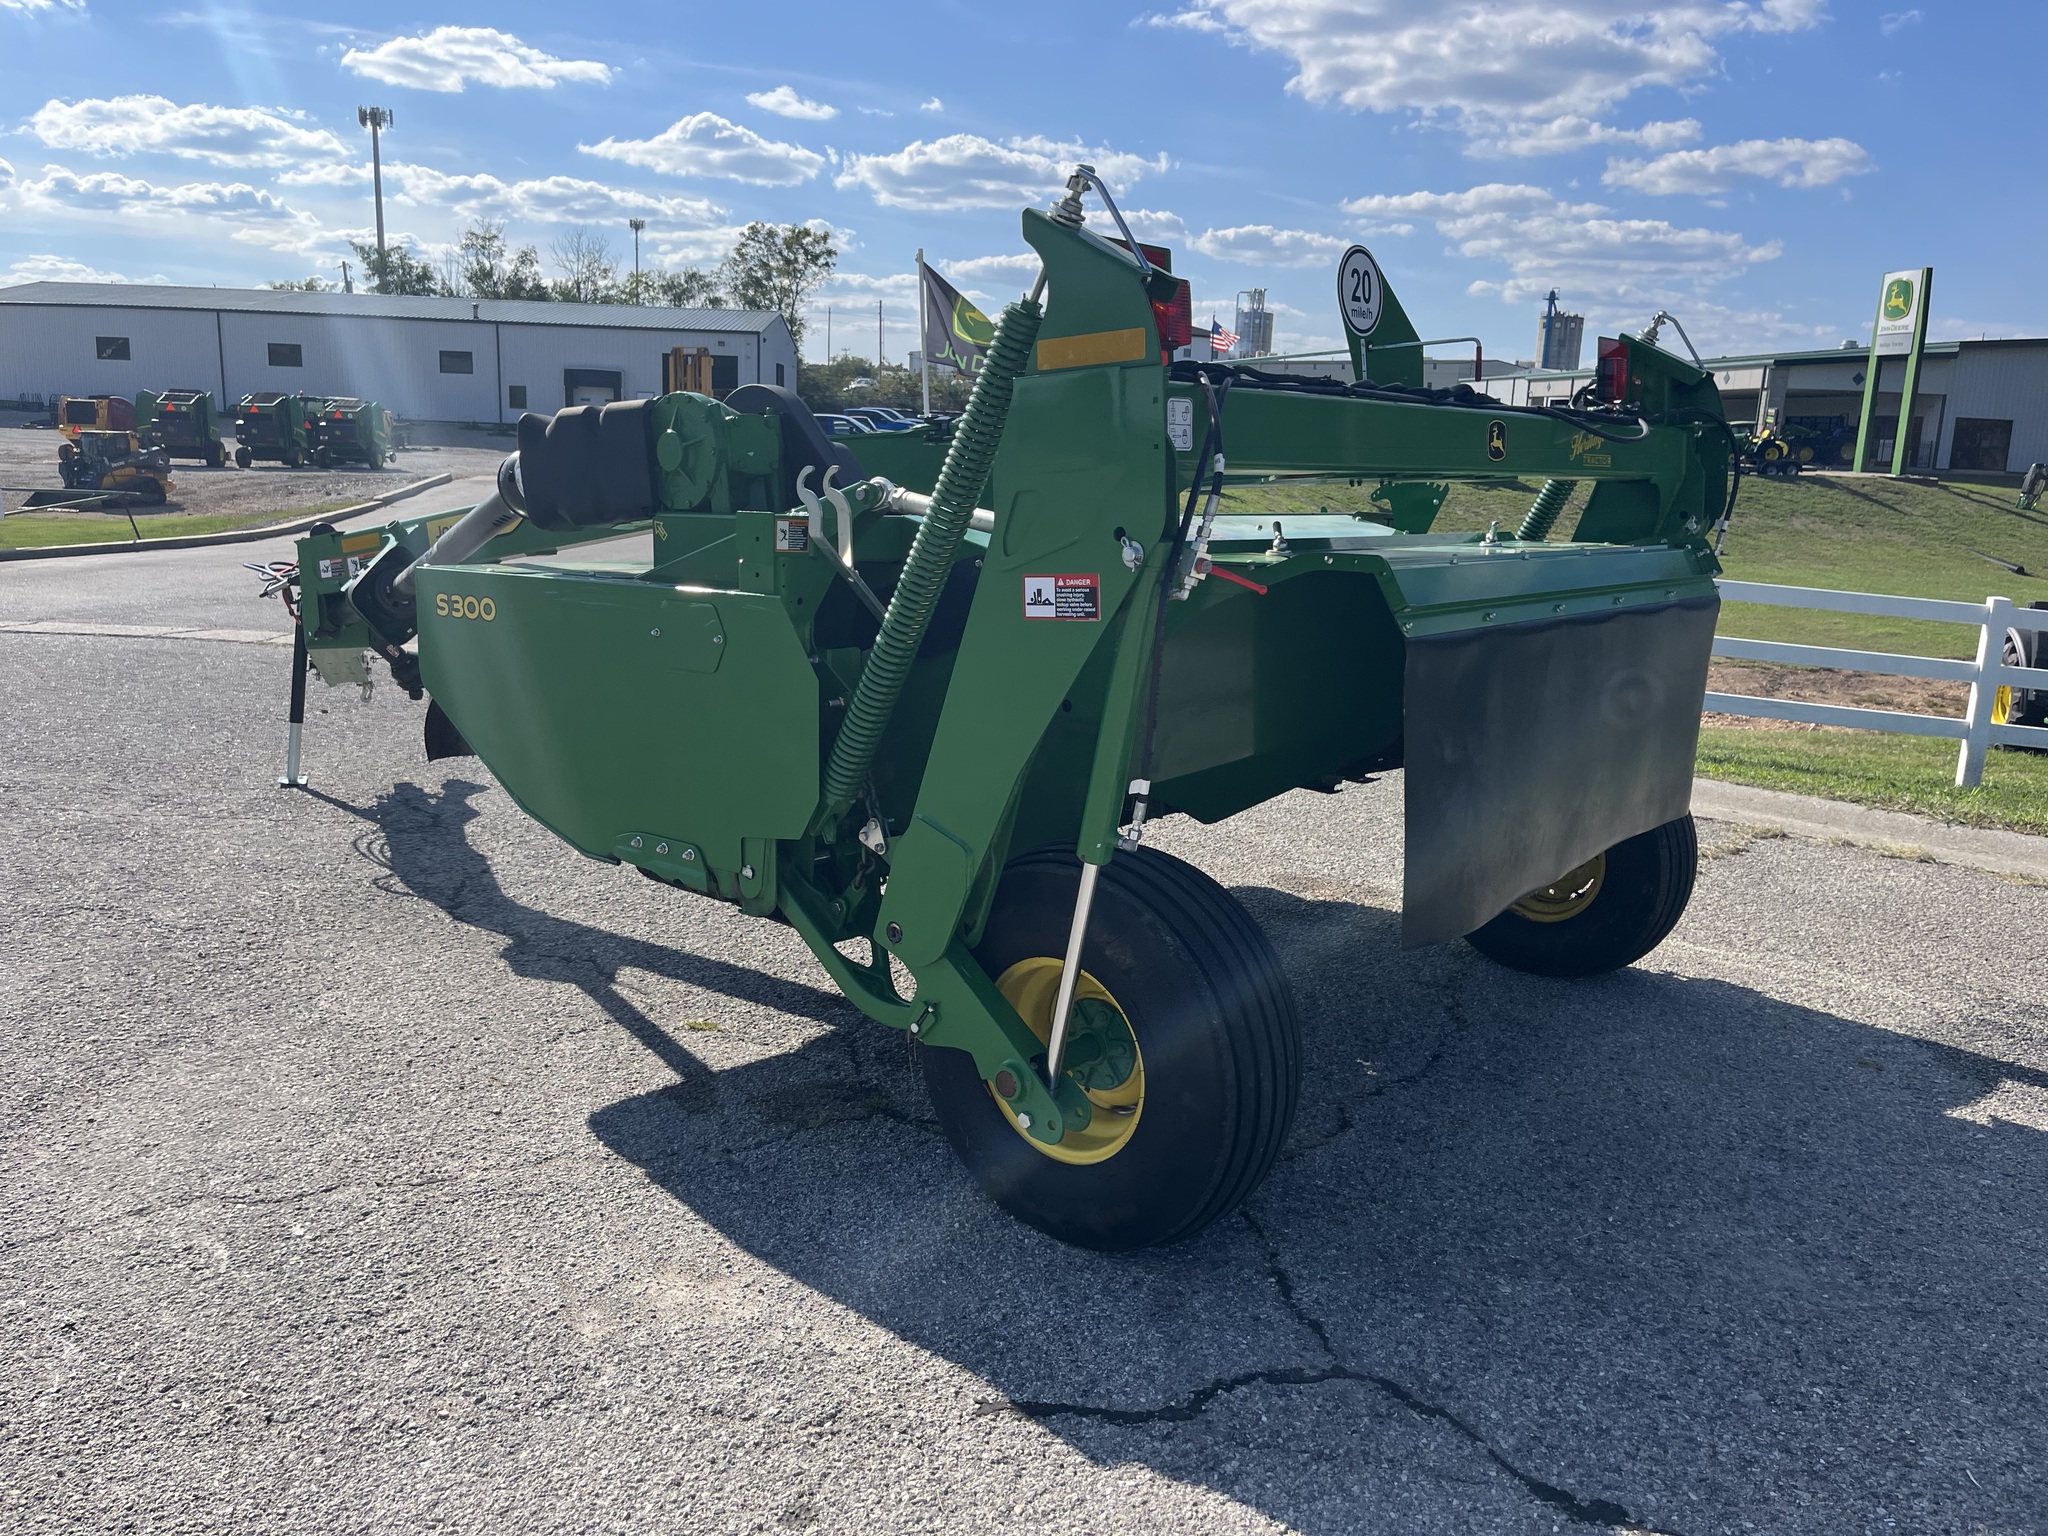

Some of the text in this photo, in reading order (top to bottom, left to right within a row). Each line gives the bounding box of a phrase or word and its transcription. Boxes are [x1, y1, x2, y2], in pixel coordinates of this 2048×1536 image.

[1350, 268, 1372, 304] 20
[1351, 306, 1373, 320] mile/h
[436, 592, 497, 622] S300
